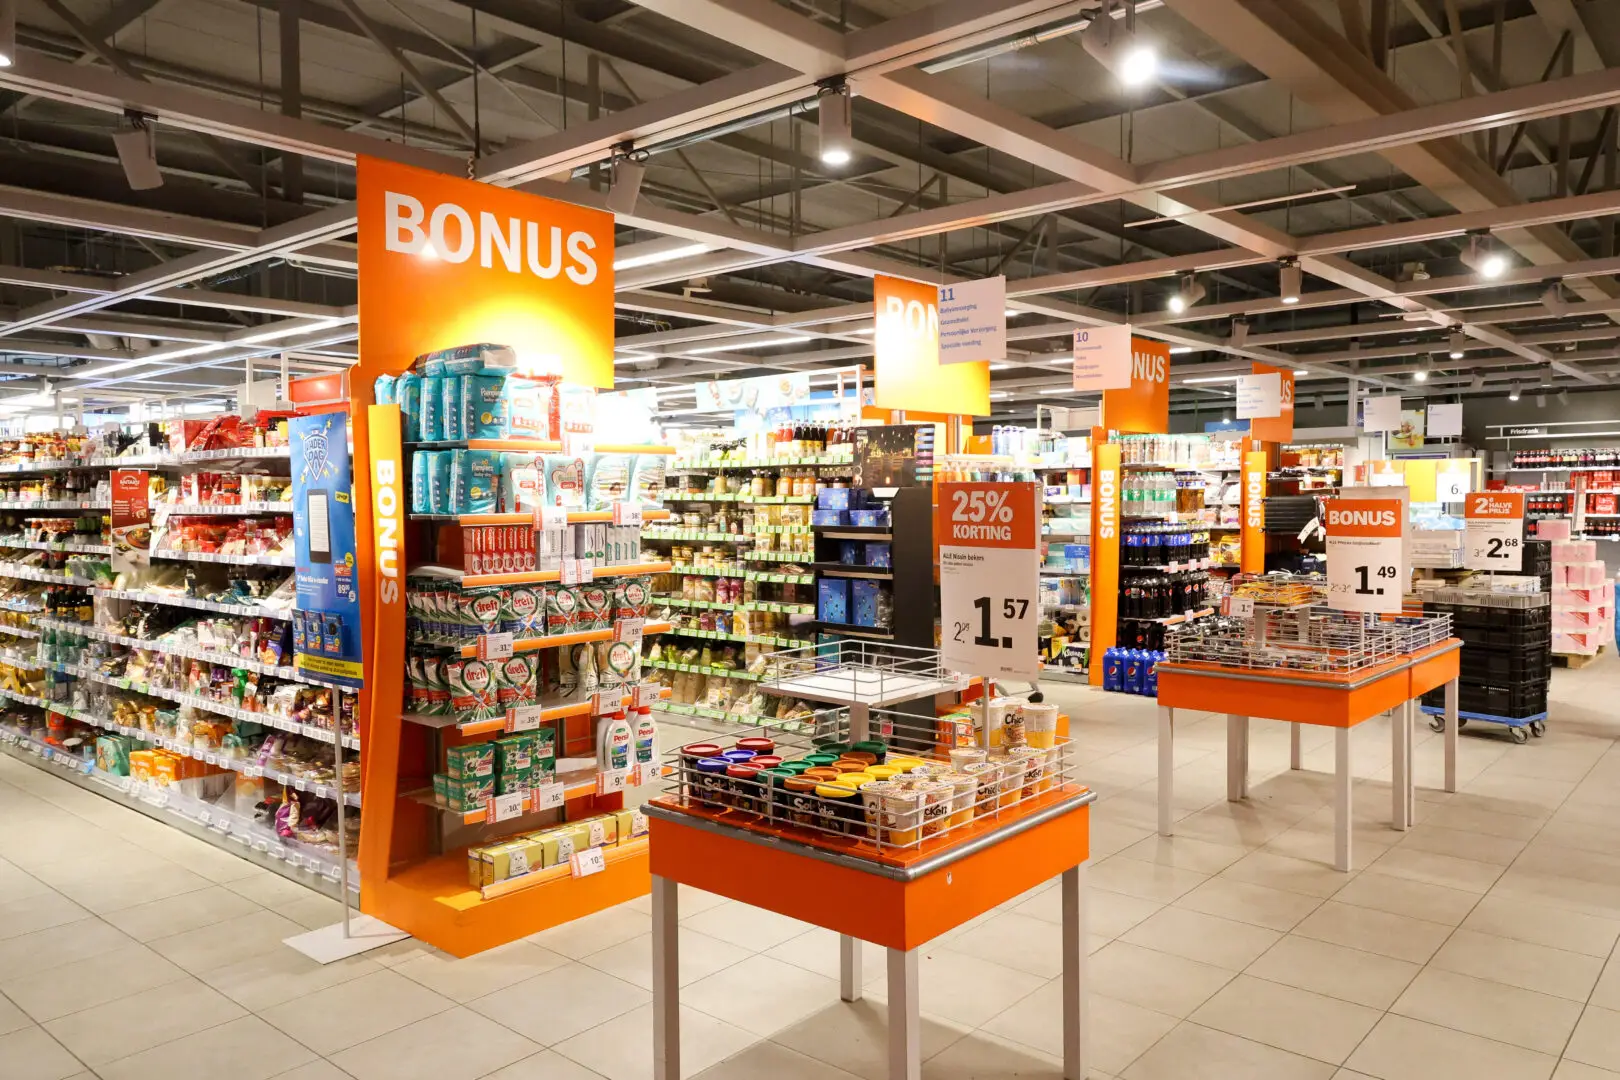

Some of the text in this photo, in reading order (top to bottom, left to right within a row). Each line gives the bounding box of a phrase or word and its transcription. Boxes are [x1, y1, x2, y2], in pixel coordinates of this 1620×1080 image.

[385, 190, 598, 286] BONUS
[940, 288, 955, 302] 11
[1076, 331, 1089, 343] 10
[1510, 427, 1539, 435] Frisdrank
[952, 490, 1013, 523] 25%
[1099, 469, 1115, 539] BONUS
[1247, 471, 1262, 527] BONUS
[1329, 510, 1396, 526] BONUS
[377, 459, 399, 605] BONUS
[953, 524, 1012, 541] KORTING
[1486, 537, 1518, 558] 2.68
[1355, 566, 1397, 595] 1.49
[973, 596, 1029, 649] 1.57
[613, 733, 629, 742] Persil
